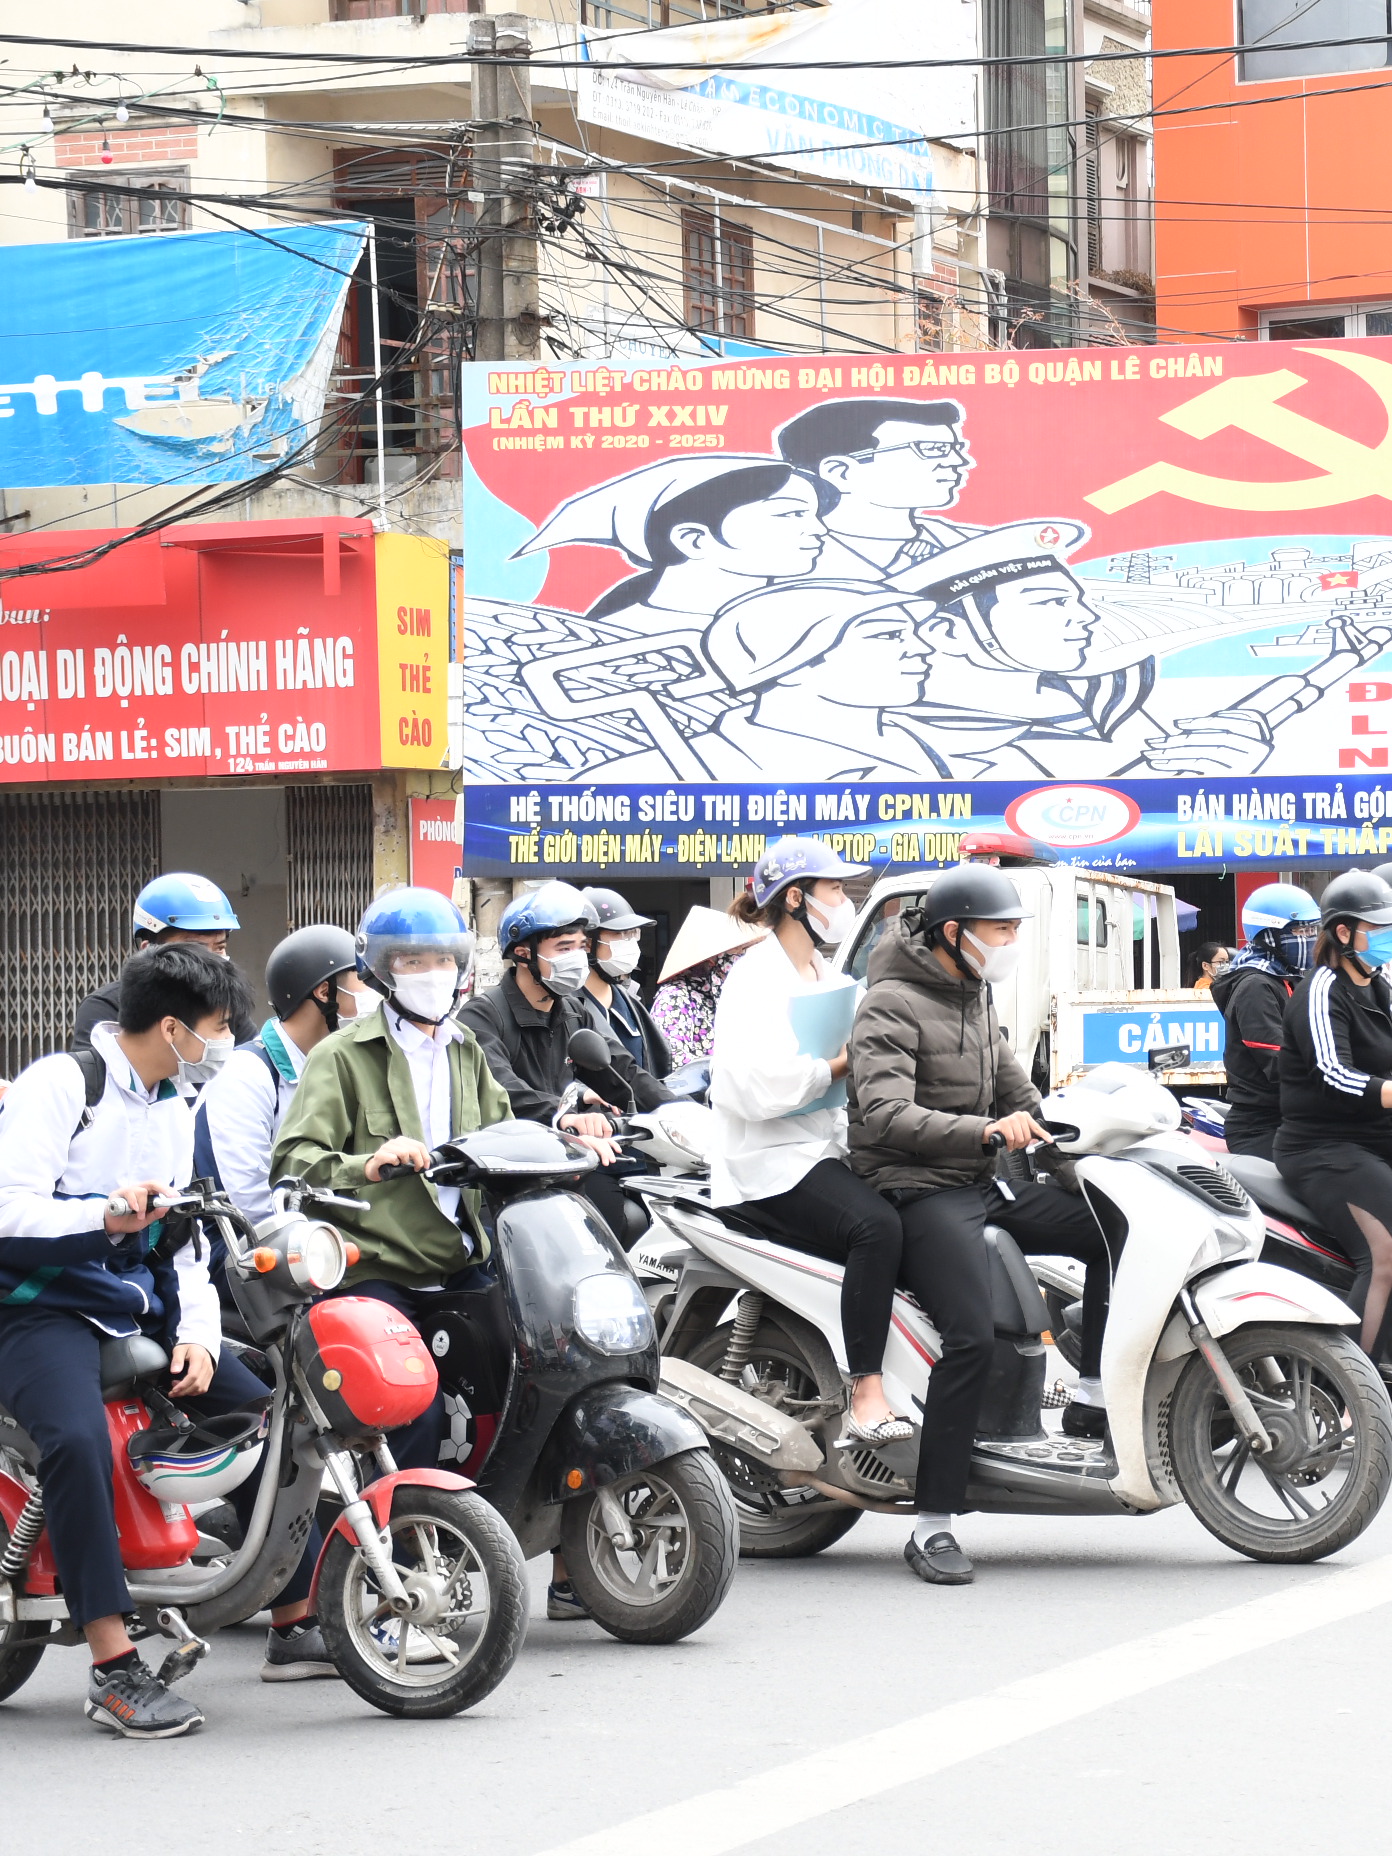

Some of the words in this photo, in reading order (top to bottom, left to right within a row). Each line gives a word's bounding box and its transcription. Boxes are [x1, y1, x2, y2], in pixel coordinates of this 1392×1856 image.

[748, 87, 885, 139] ECONOMIC
[489, 368, 563, 397] NHIỆT
[571, 367, 625, 396] LIỆT
[633, 365, 702, 391] CHÀO
[713, 366, 790, 390] MỪNG
[798, 367, 842, 392] ĐẠI
[852, 363, 894, 391] HỘI
[902, 360, 976, 386] ĐẢNG
[984, 360, 1020, 387] BỘ
[1029, 358, 1101, 386] QUẬN
[1111, 356, 1141, 380] LÊ
[1149, 353, 1223, 378] CHÂN
[490, 399, 558, 429] LẦN
[569, 403, 641, 428] THỨ
[647, 405, 729, 427] XXIV
[493, 433, 564, 451] (NHIỆM
[571, 433, 595, 449] KỲ
[601, 435, 649, 448] 2020
[670, 434, 725, 448] 2025)
[950, 579, 970, 592] HẢI
[968, 569, 998, 584] QUÂN
[998, 563, 1023, 574] VIỆT
[1026, 559, 1052, 570] NAM
[397, 606, 431, 638] SIM
[57, 648, 85, 699] DI
[94, 634, 173, 708] ĐỘNG
[180, 629, 268, 695] CHÍNH
[275, 626, 355, 689] HÃNG
[399, 653, 432, 695] THẺ
[63, 725, 113, 762] BÁN
[120, 717, 158, 760] LẺ:
[225, 712, 270, 755] THẺ
[278, 716, 326, 754] CÀO
[399, 709, 432, 747] CÀO
[228, 757, 254, 773] 124
[255, 759, 275, 771] TRẦN
[509, 790, 541, 827] HỆ
[548, 787, 630, 822] THỐNG
[638, 790, 695, 822] SIÊU
[702, 794, 740, 827] THỊ
[748, 790, 806, 827] ĐIỆN
[815, 789, 870, 821] MÁY
[878, 793, 972, 821] CPN.VN
[1059, 805, 1107, 823] CPN
[1177, 789, 1228, 822] BÁN
[1233, 788, 1296, 821] HÀNG
[1303, 783, 1348, 820] TRẢ
[509, 826, 540, 863] THẾ
[543, 829, 578, 863] GIỚI
[581, 829, 621, 869] ĐIỆN
[625, 829, 663, 863] MÁY
[678, 829, 720, 869] ĐIỆN
[722, 833, 767, 869] LẠNH
[891, 832, 921, 863] GIA
[1177, 823, 1223, 858] LÃI
[1234, 820, 1315, 857] SUẤT
[1119, 1012, 1219, 1054] CẢNH
